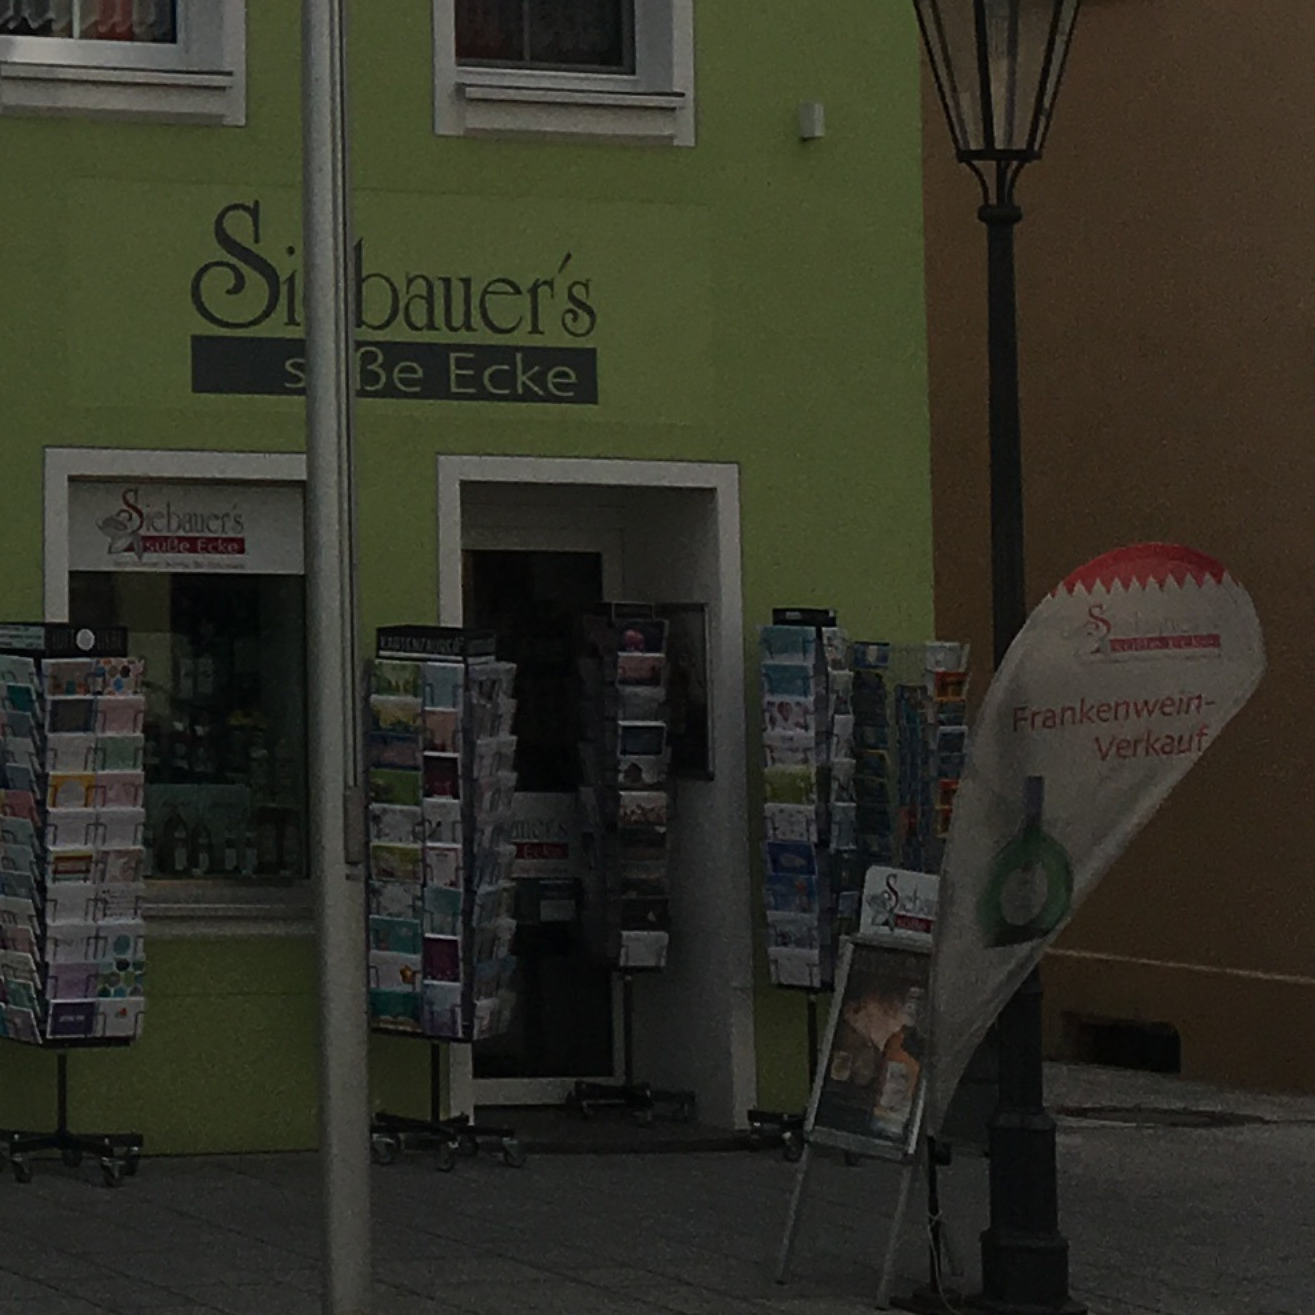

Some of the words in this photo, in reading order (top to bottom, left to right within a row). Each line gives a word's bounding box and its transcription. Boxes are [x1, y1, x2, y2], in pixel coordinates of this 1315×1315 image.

[283, 346, 424, 393] sße
[449, 352, 577, 397] Ecke
[196, 539, 239, 554] Ecke
[1012, 694, 1216, 733] Frankenwein-
[1094, 723, 1210, 762] Verkauf
